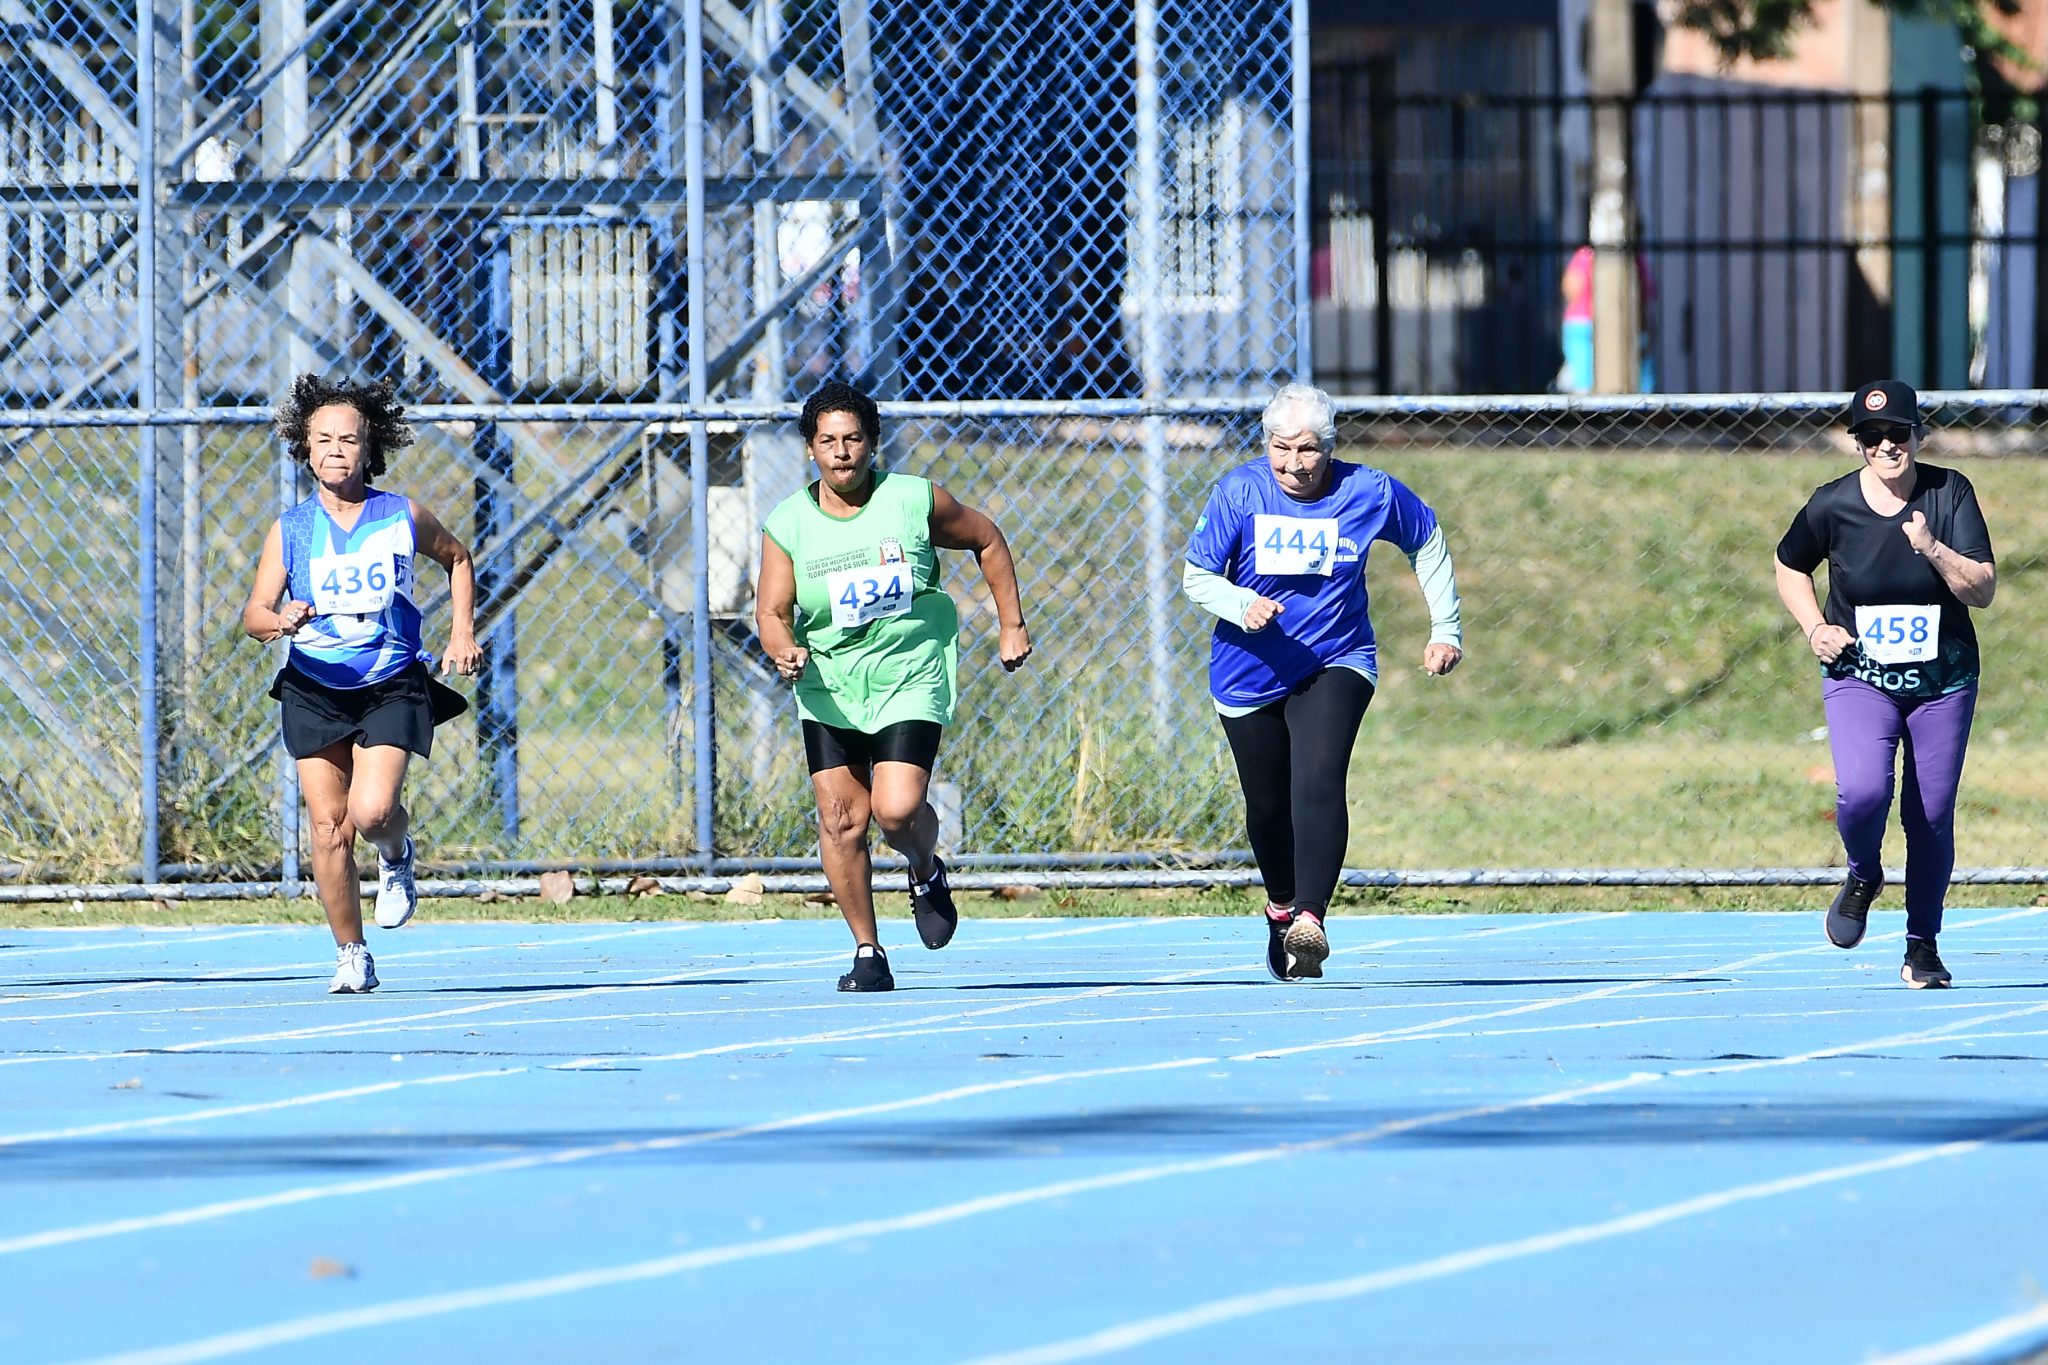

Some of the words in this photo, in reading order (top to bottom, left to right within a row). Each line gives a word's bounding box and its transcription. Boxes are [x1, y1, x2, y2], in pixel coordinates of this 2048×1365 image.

[1264, 527, 1328, 555] 444
[321, 562, 387, 597] 436
[843, 563, 852, 571] DA
[840, 575, 904, 609] 434
[1865, 616, 1929, 645] 458
